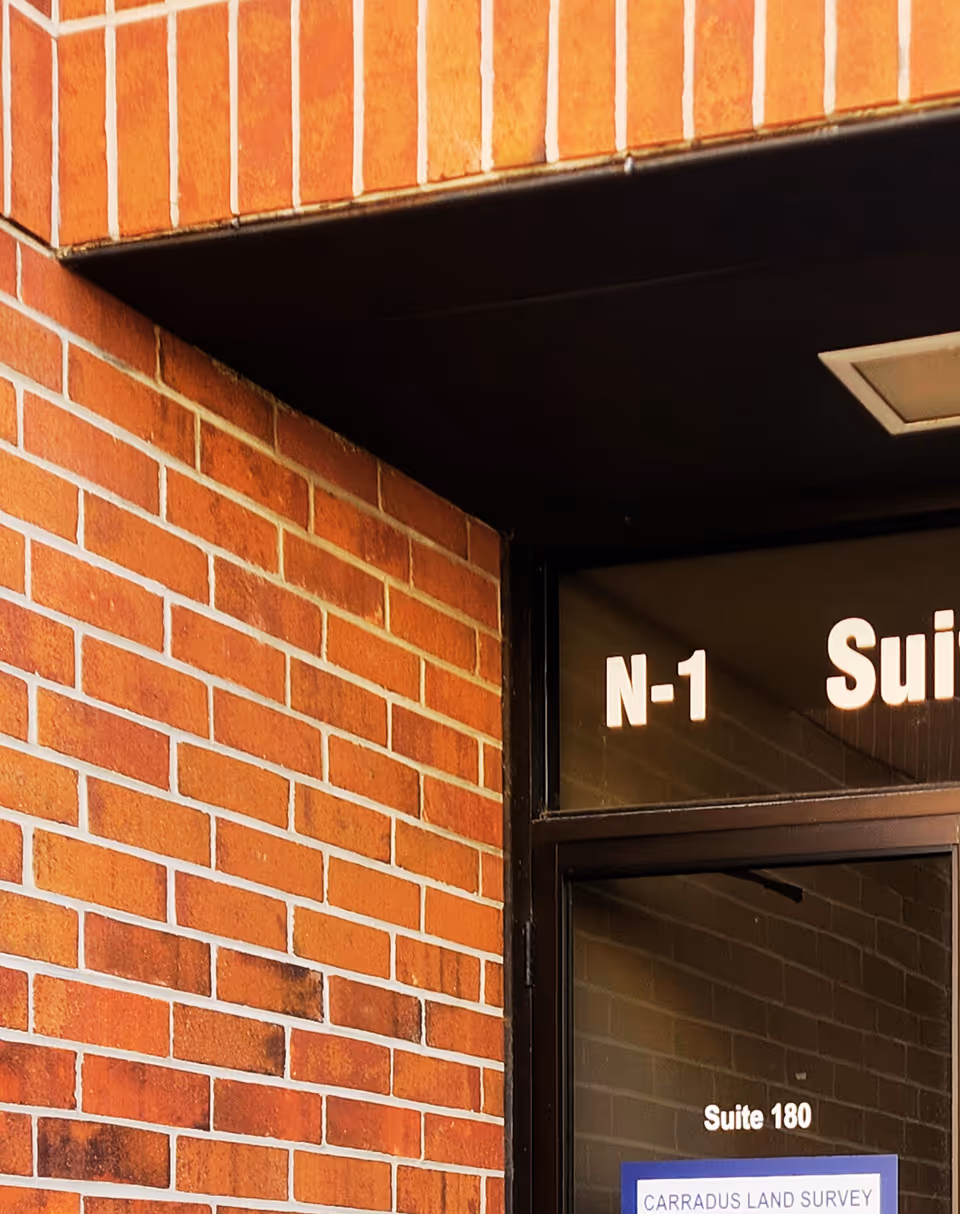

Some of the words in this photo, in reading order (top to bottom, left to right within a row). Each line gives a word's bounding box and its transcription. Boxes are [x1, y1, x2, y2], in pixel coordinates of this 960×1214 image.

[605, 648, 708, 728] N-1
[703, 1104, 764, 1131] Suite
[770, 1102, 812, 1130] 180
[643, 1192, 741, 1212] CARRADUS
[746, 1190, 795, 1210] LAND
[800, 1188, 873, 1209] SURVEY
